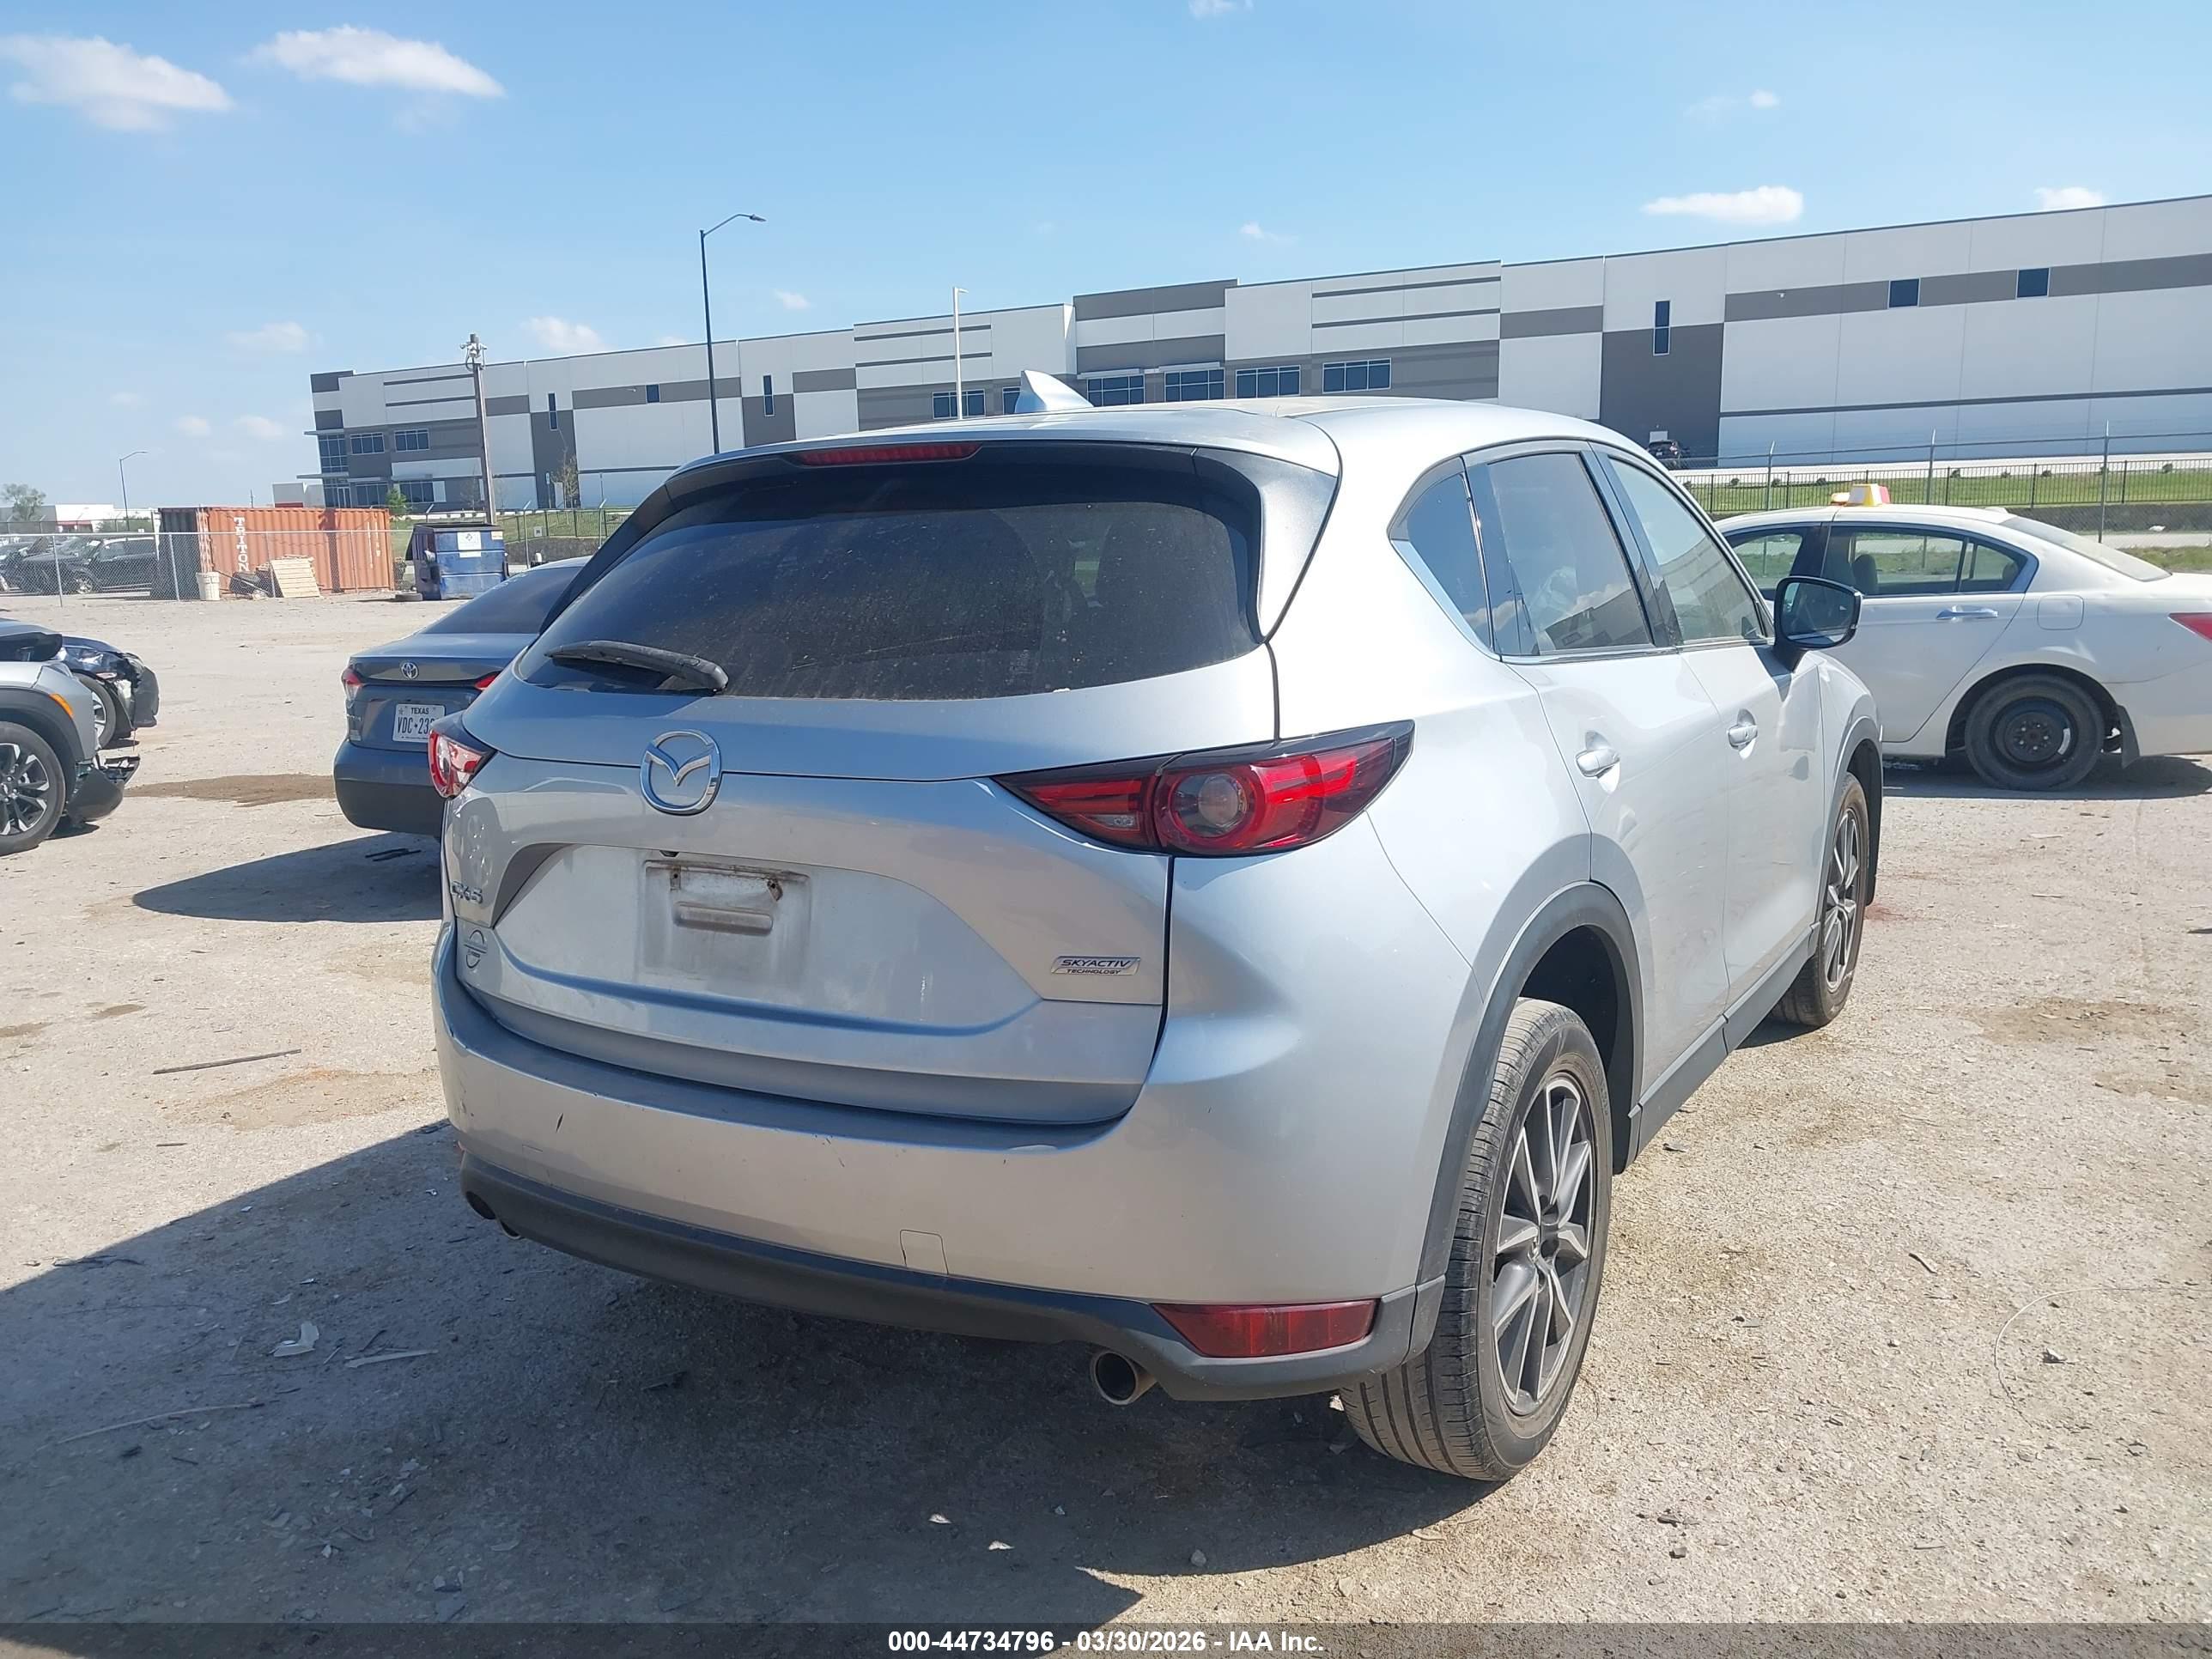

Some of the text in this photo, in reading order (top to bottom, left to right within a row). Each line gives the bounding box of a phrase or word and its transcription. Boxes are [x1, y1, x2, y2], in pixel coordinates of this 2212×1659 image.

[233, 516, 250, 572] TRITON
[411, 707, 430, 715] TEXAS
[1060, 959, 1131, 968] SKYACTIV
